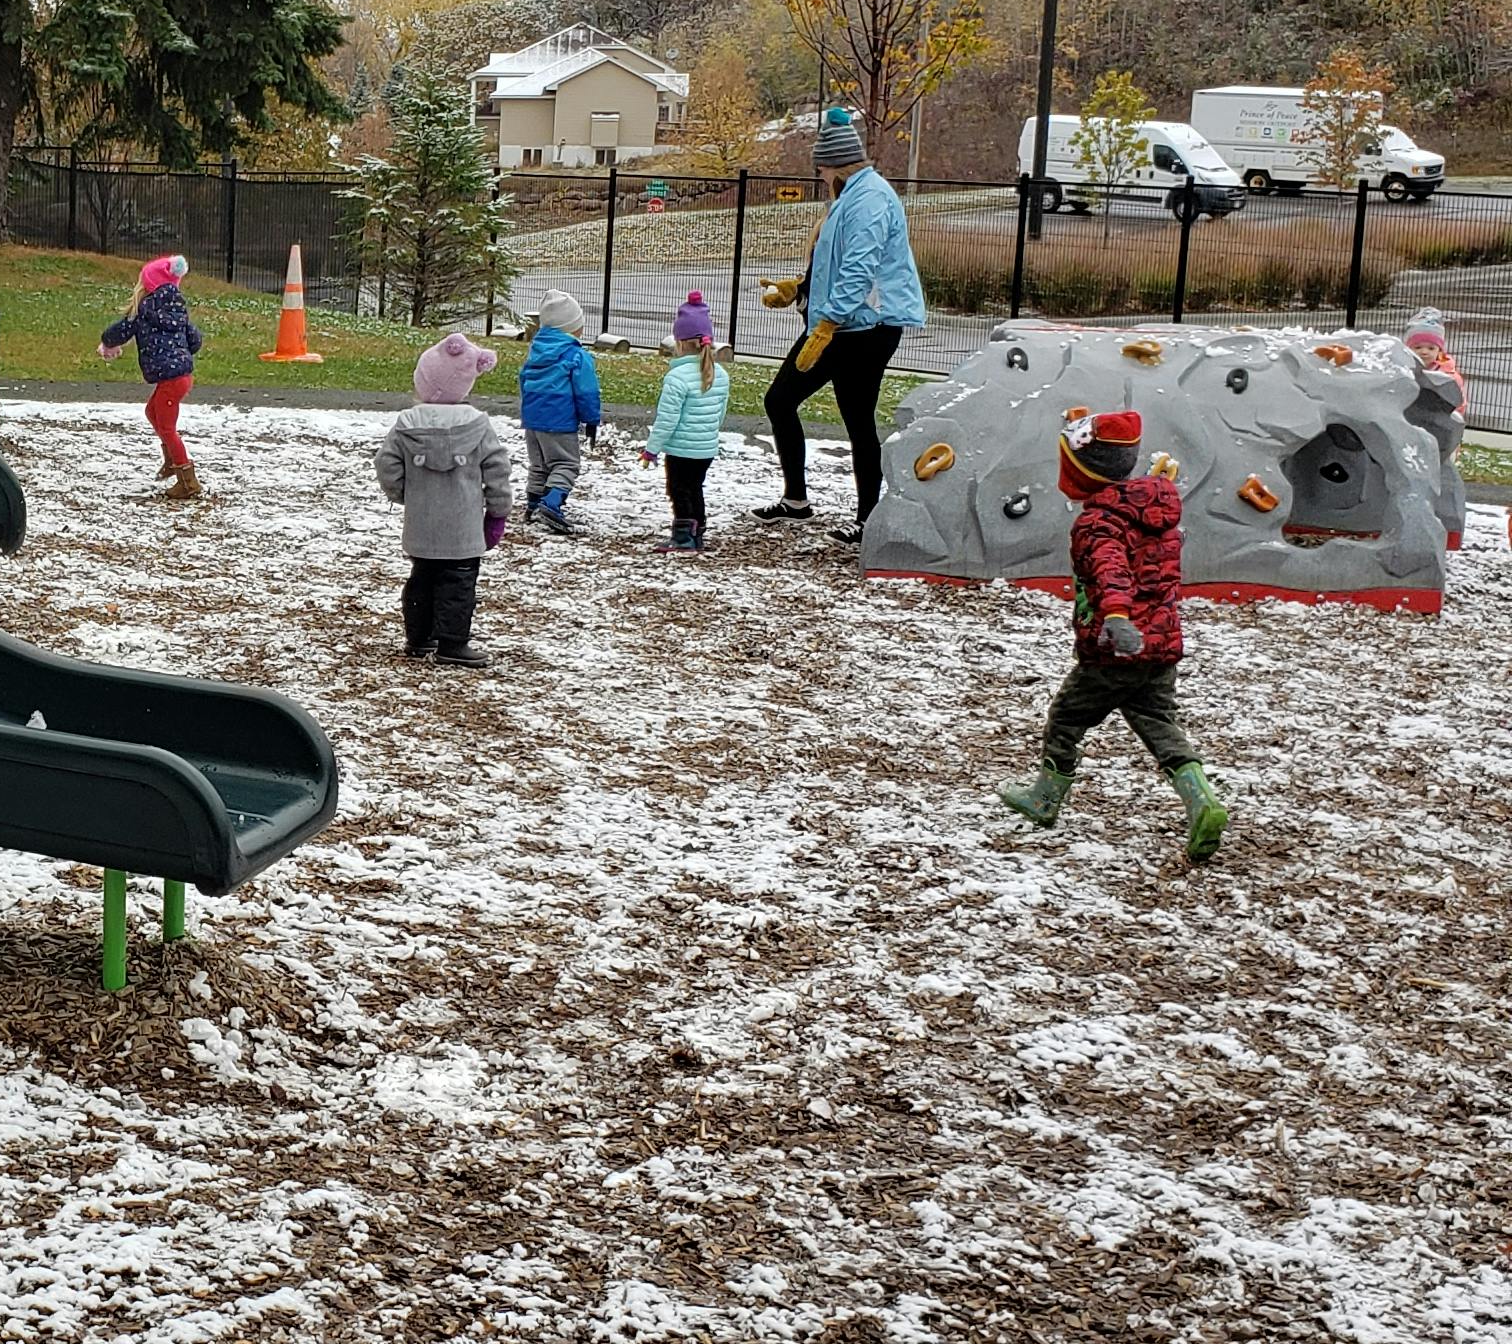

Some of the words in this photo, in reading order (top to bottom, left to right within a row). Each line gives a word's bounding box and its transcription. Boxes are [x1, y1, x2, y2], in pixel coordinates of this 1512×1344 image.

[1239, 109, 1264, 118] Prince
[1266, 111, 1276, 120] of
[1276, 111, 1298, 120] Peace
